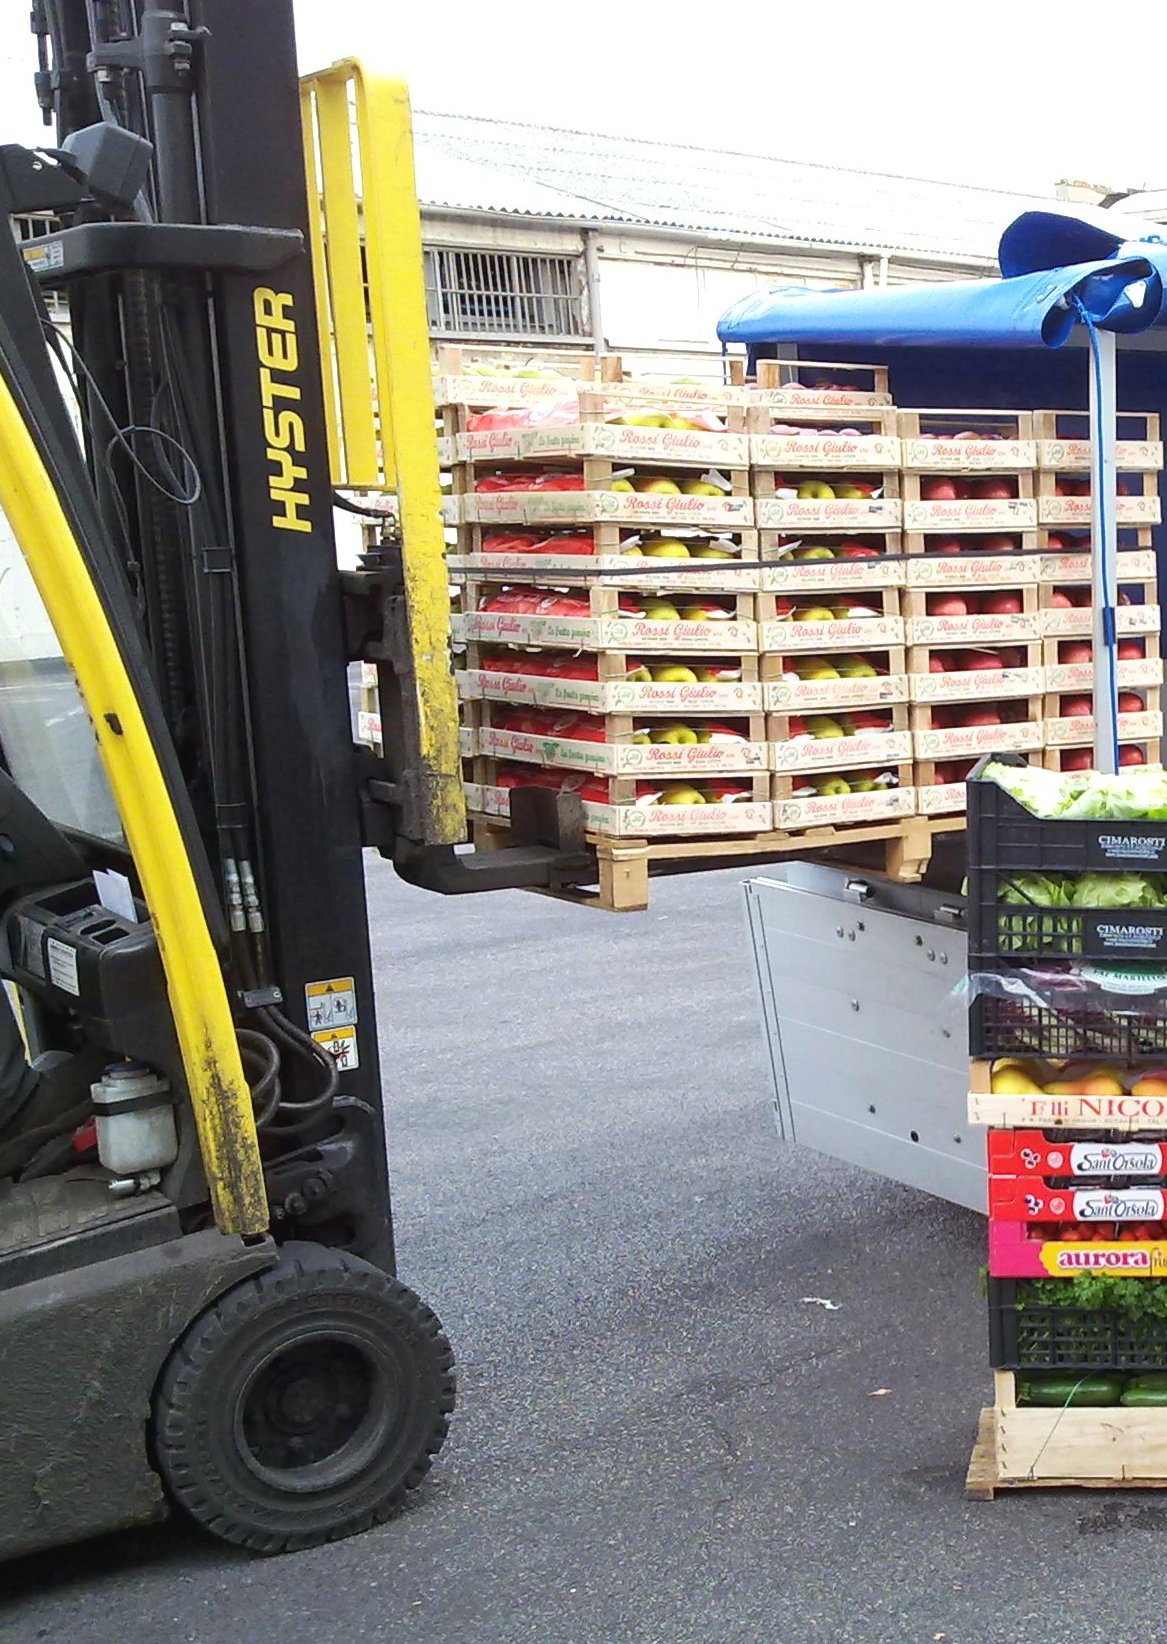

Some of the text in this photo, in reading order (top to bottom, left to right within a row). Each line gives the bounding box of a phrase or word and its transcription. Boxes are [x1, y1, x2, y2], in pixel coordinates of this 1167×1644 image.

[253, 286, 312, 533] HYSTER
[620, 430, 701, 448] Rossi Giulio
[785, 441, 858, 456] Rossi Giulio
[931, 444, 996, 460] Rossi Giulio
[624, 496, 705, 514] Rossi Giulio
[787, 503, 859, 519] Rossi Giulio
[632, 622, 712, 640] Rossi Giulio
[790, 622, 861, 639] Rossi Giulio
[640, 686, 717, 702] Rossi Giulio
[647, 747, 725, 763] Rossi Giulio
[946, 789, 965, 799] Ros
[1098, 835, 1166, 847] CIMAROSTI
[1096, 924, 1163, 936] CIMAROSTI
[1059, 1252, 1148, 1267] aurora
